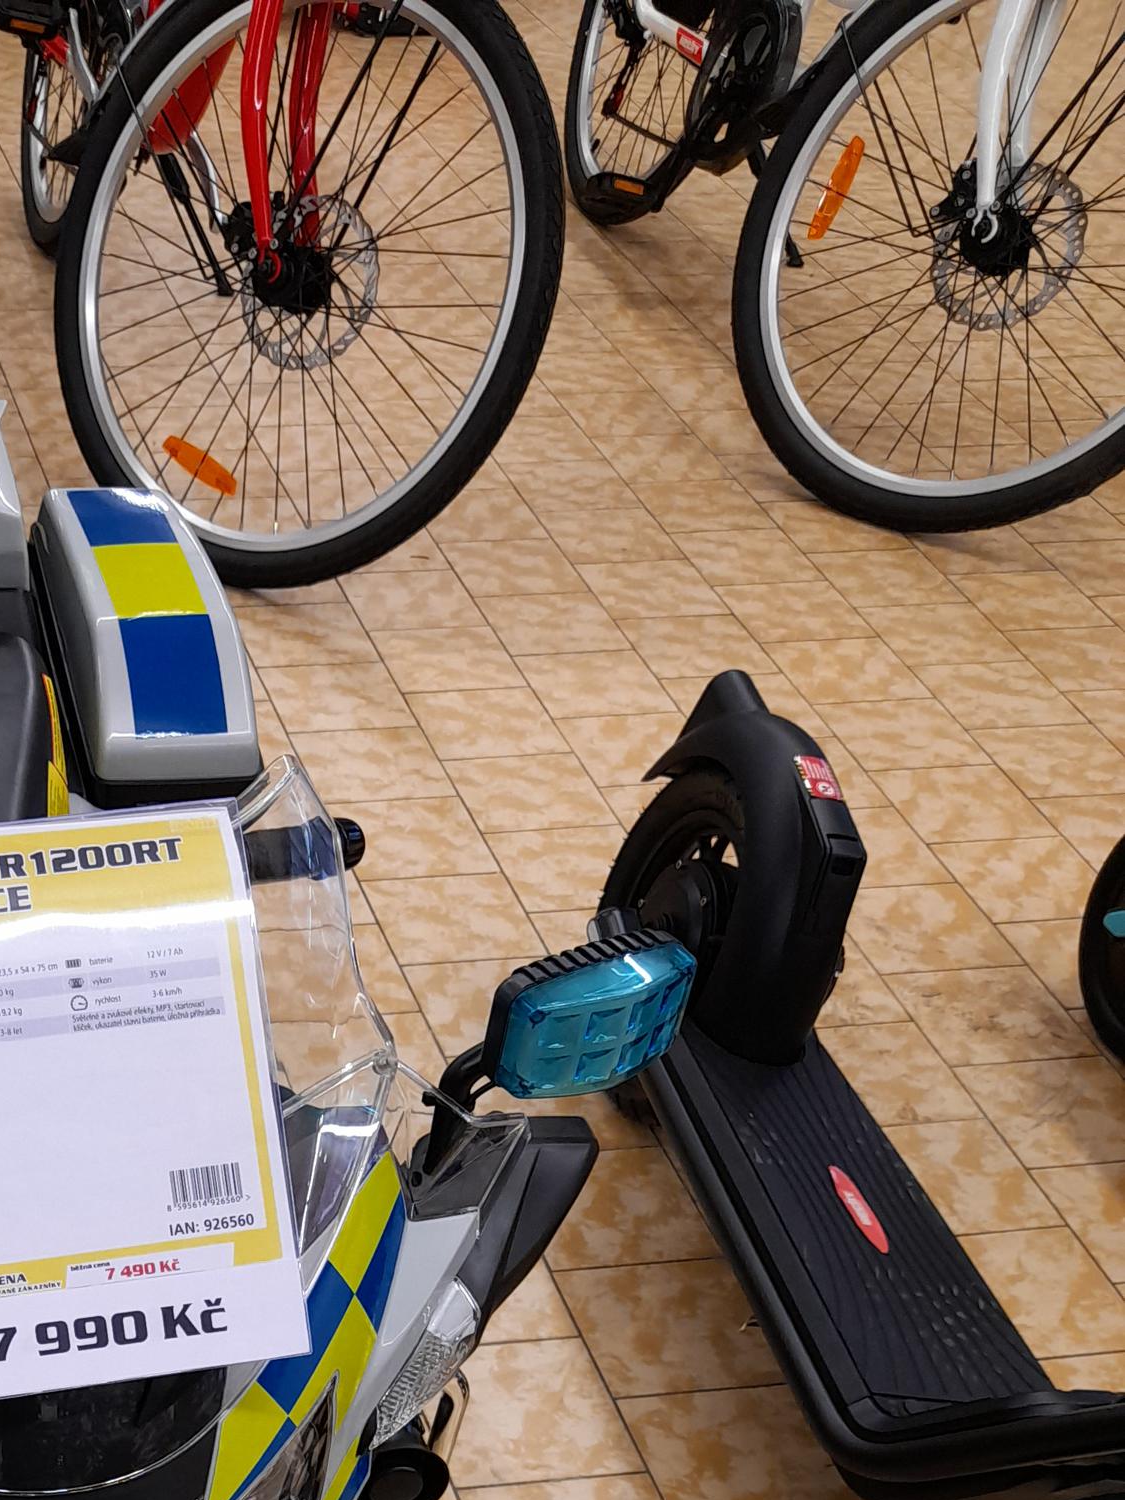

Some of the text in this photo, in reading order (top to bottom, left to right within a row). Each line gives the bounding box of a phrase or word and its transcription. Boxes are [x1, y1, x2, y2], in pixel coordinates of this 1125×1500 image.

[147, 950, 155, 959] 12
[173, 947, 184, 956] Ah
[20, 966, 30, 974] 54
[37, 963, 46, 972] 75
[47, 963, 58, 971] cm
[150, 969, 158, 978] 35
[159, 969, 167, 977] W
[5, 988, 14, 997] kg
[94, 995, 121, 1006] rychlost
[164, 987, 183, 996] km/h
[13, 1007, 23, 1016] kg
[13, 1027, 23, 1035] let
[177, 1200, 208, 1211] 595614
[210, 1195, 241, 1206] 926560
[169, 1213, 255, 1237] IAN: 926560
[93, 1261, 111, 1269] cena
[105, 1258, 181, 1281] 7 490 Kč
[35, 1308, 149, 1357] 990
[160, 1297, 228, 1340] Kč
